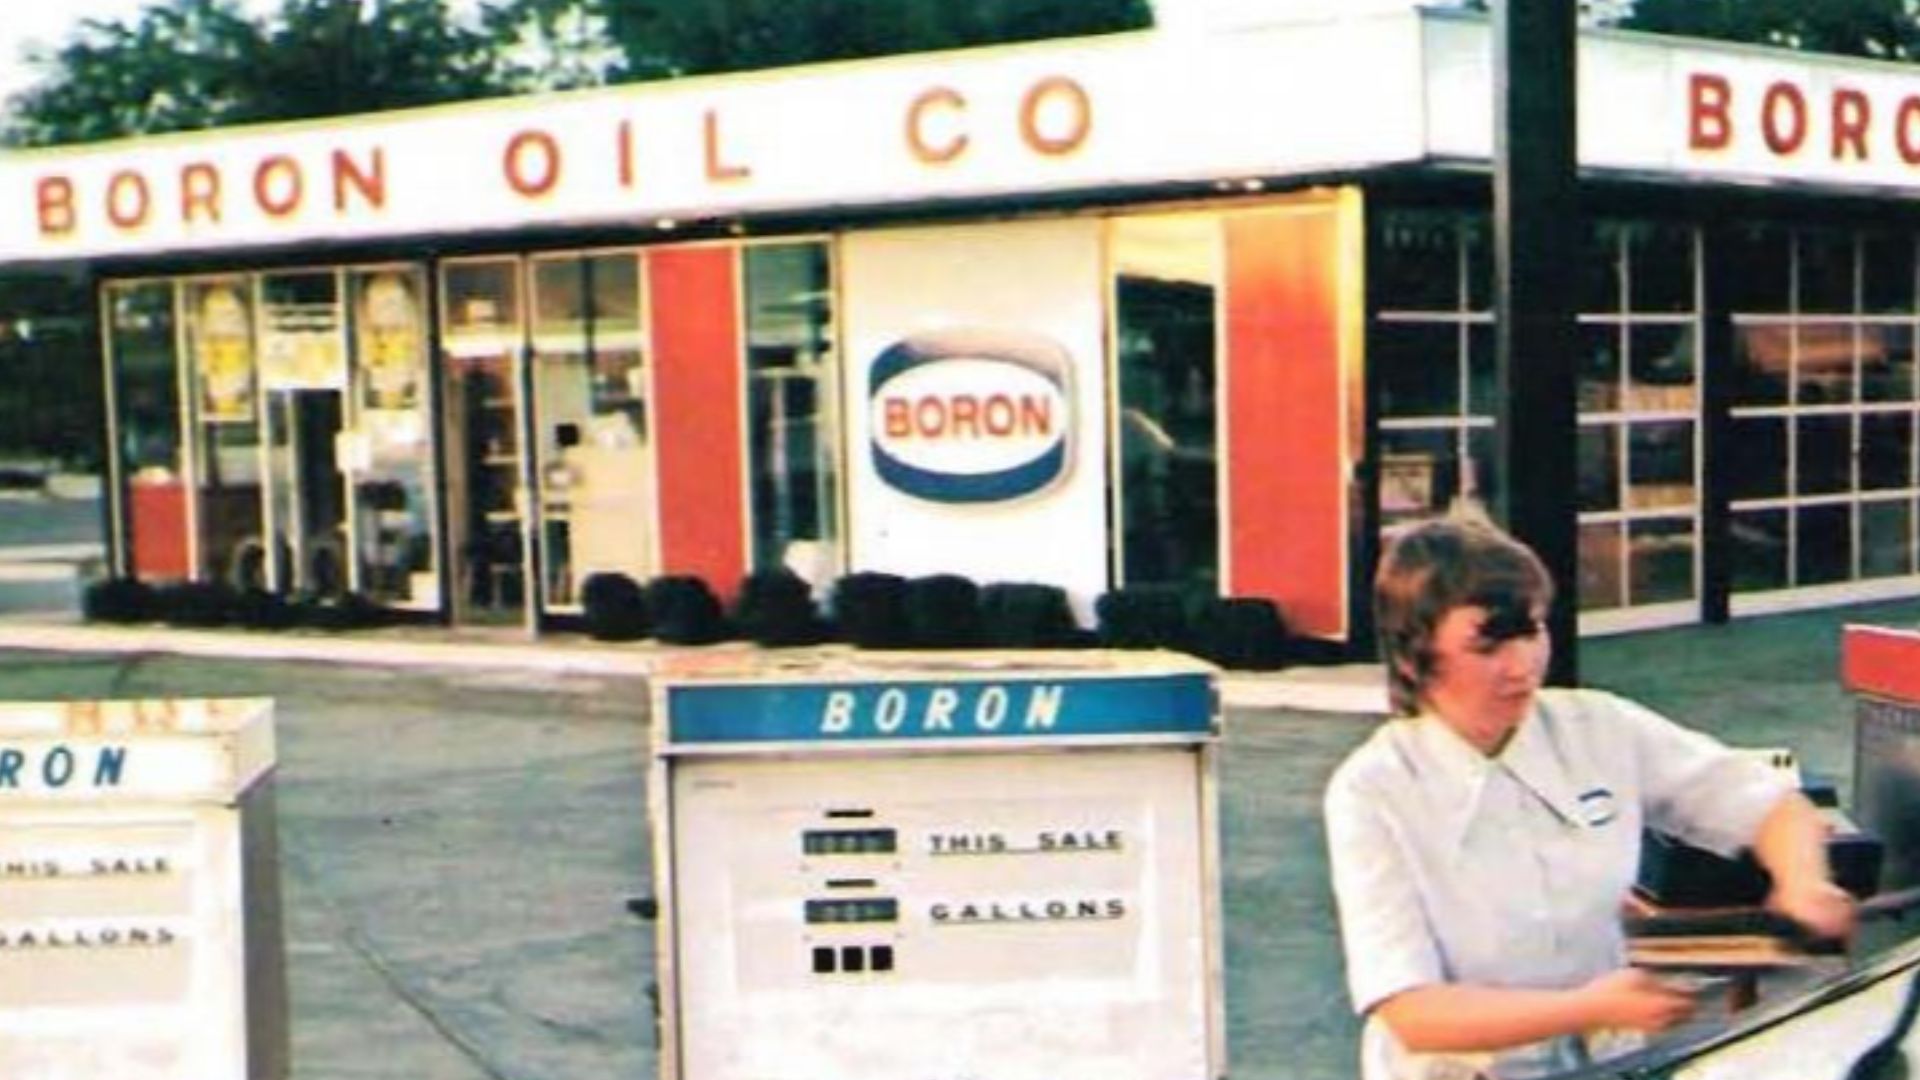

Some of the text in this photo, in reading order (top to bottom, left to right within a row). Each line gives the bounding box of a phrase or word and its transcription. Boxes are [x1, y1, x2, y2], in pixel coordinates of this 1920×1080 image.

[36, 76, 1091, 233] BORON OIL CO
[884, 394, 1050, 438] BORON
[820, 685, 1062, 733] BORON
[930, 829, 1122, 853] THIS SALE
[91, 857, 171, 874] SALE
[930, 900, 1125, 920] GALLONS
